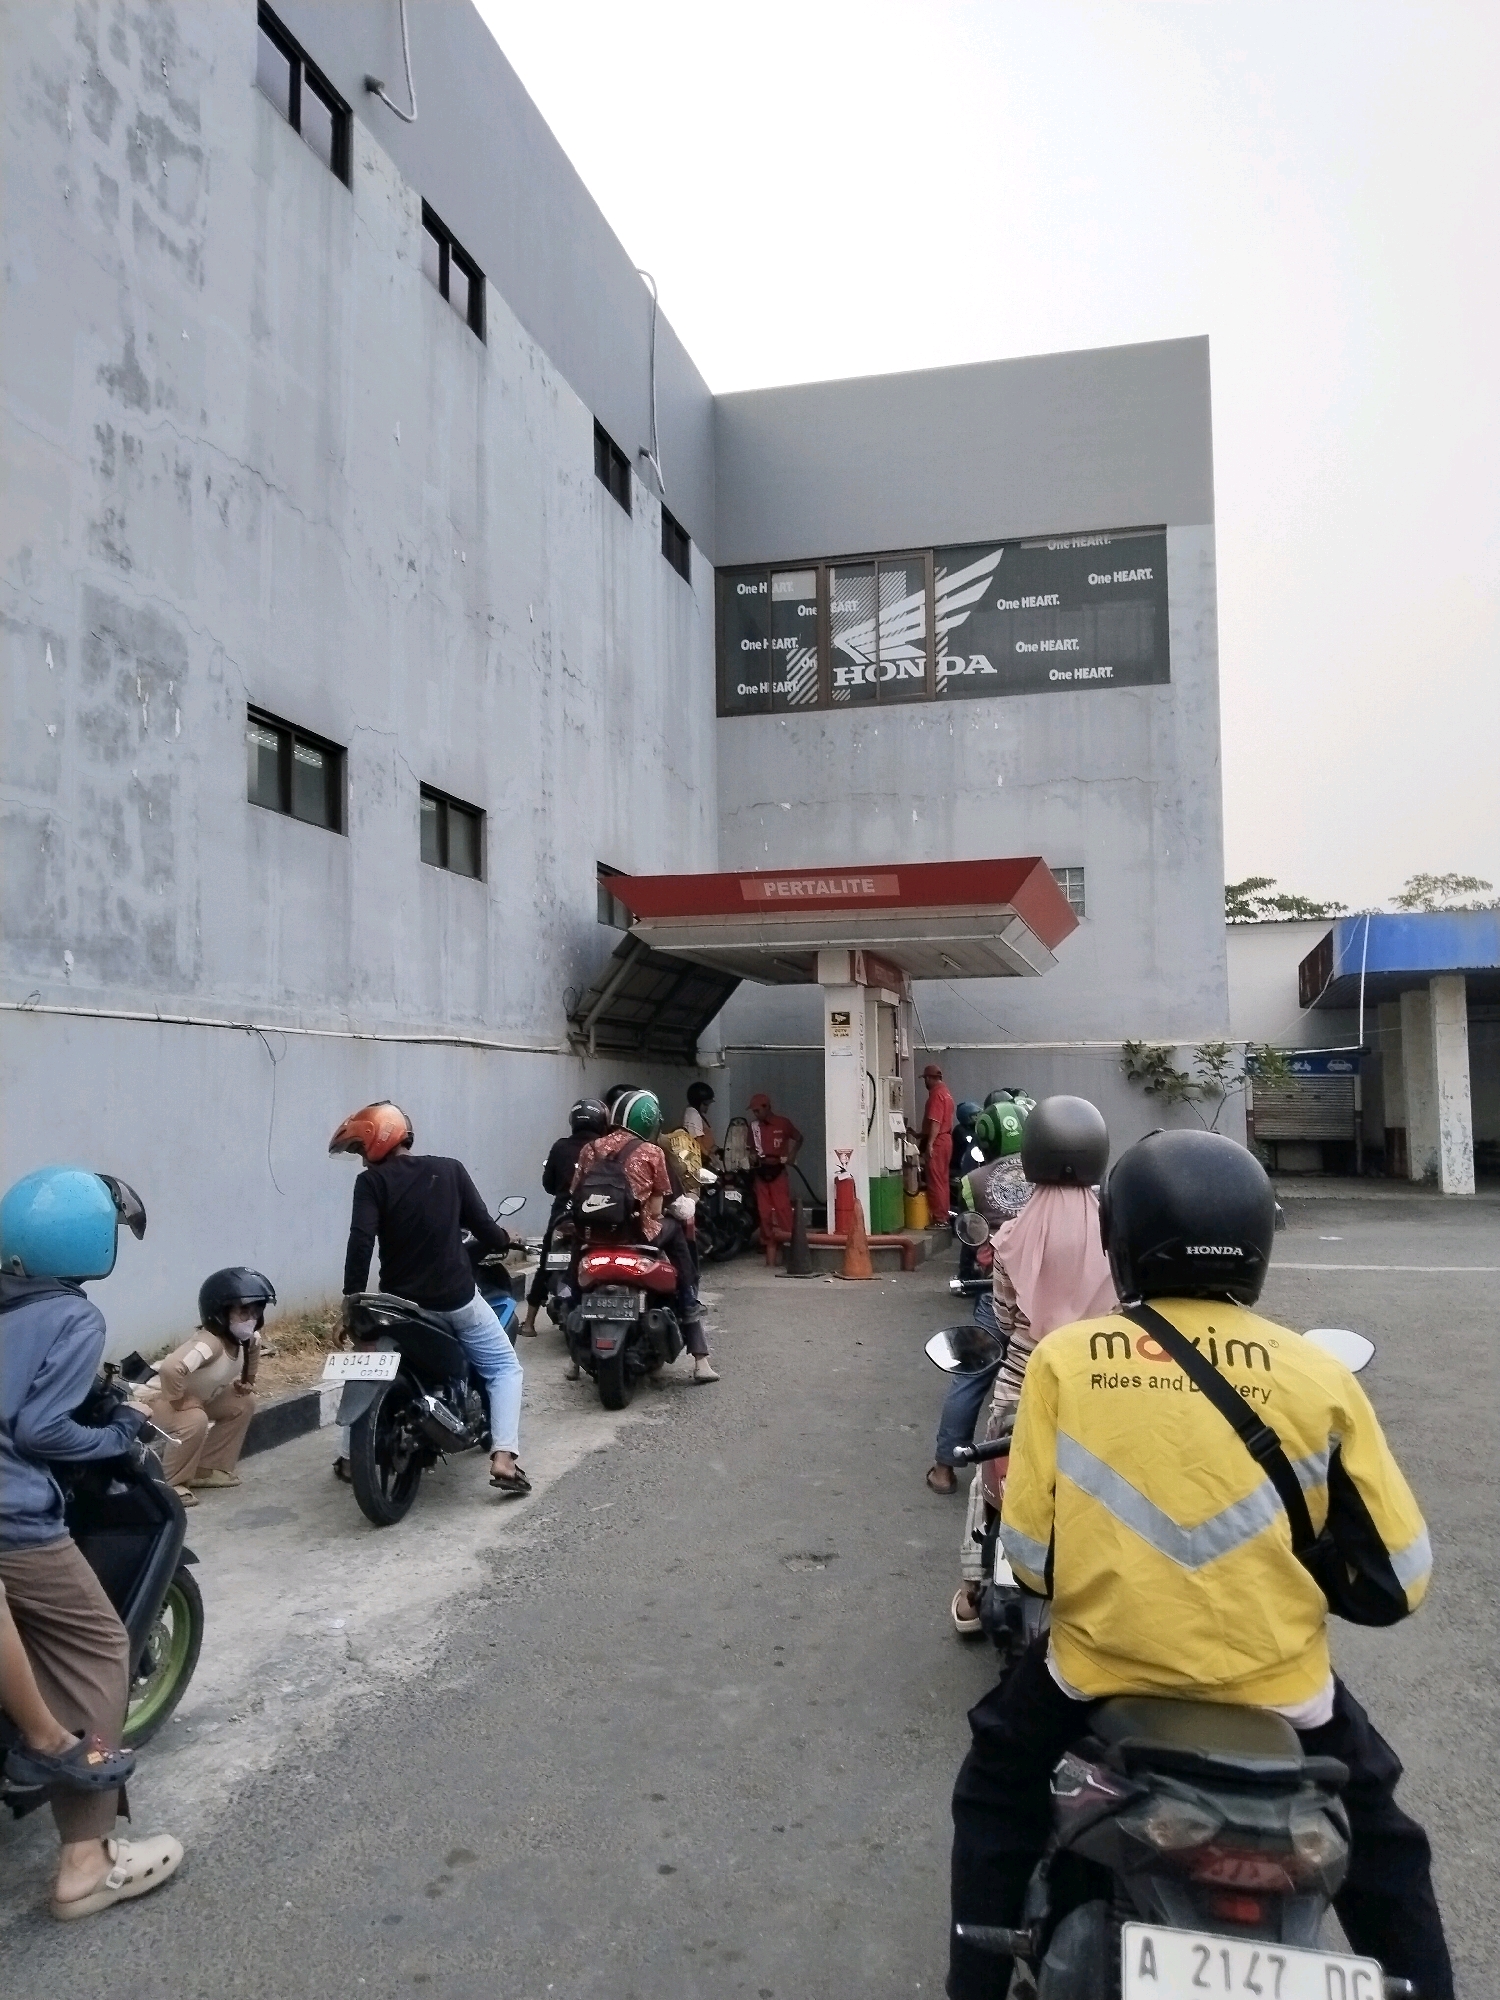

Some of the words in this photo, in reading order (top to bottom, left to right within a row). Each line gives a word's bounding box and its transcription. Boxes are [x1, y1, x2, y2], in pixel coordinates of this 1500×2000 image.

[1087, 573, 1112, 585] One
[1113, 568, 1154, 583] HEART.
[736, 583, 758, 595] One
[760, 581, 794, 594] HART.
[797, 604, 818, 617] One
[830, 600, 860, 613] EART.
[996, 598, 1020, 611] One
[1021, 594, 1060, 608] HEART.
[740, 639, 762, 651] One
[1015, 641, 1039, 653] One
[1040, 638, 1080, 652] HEART.
[833, 654, 998, 687] HONDA
[1048, 669, 1072, 681] One
[1074, 666, 1115, 680] HEART.
[737, 683, 759, 695] One
[763, 878, 876, 897] PERTALITE
[1186, 1246, 1244, 1257] HONDA
[1090, 1326, 1271, 1372] maim
[328, 1355, 336, 1367] A
[342, 1354, 371, 1367] 6141
[379, 1354, 397, 1367] BT
[1091, 1373, 1142, 1390] Rides
[1148, 1375, 1184, 1392] and
[1139, 1936, 1158, 1980] A
[1191, 1943, 1286, 2000] 2147
